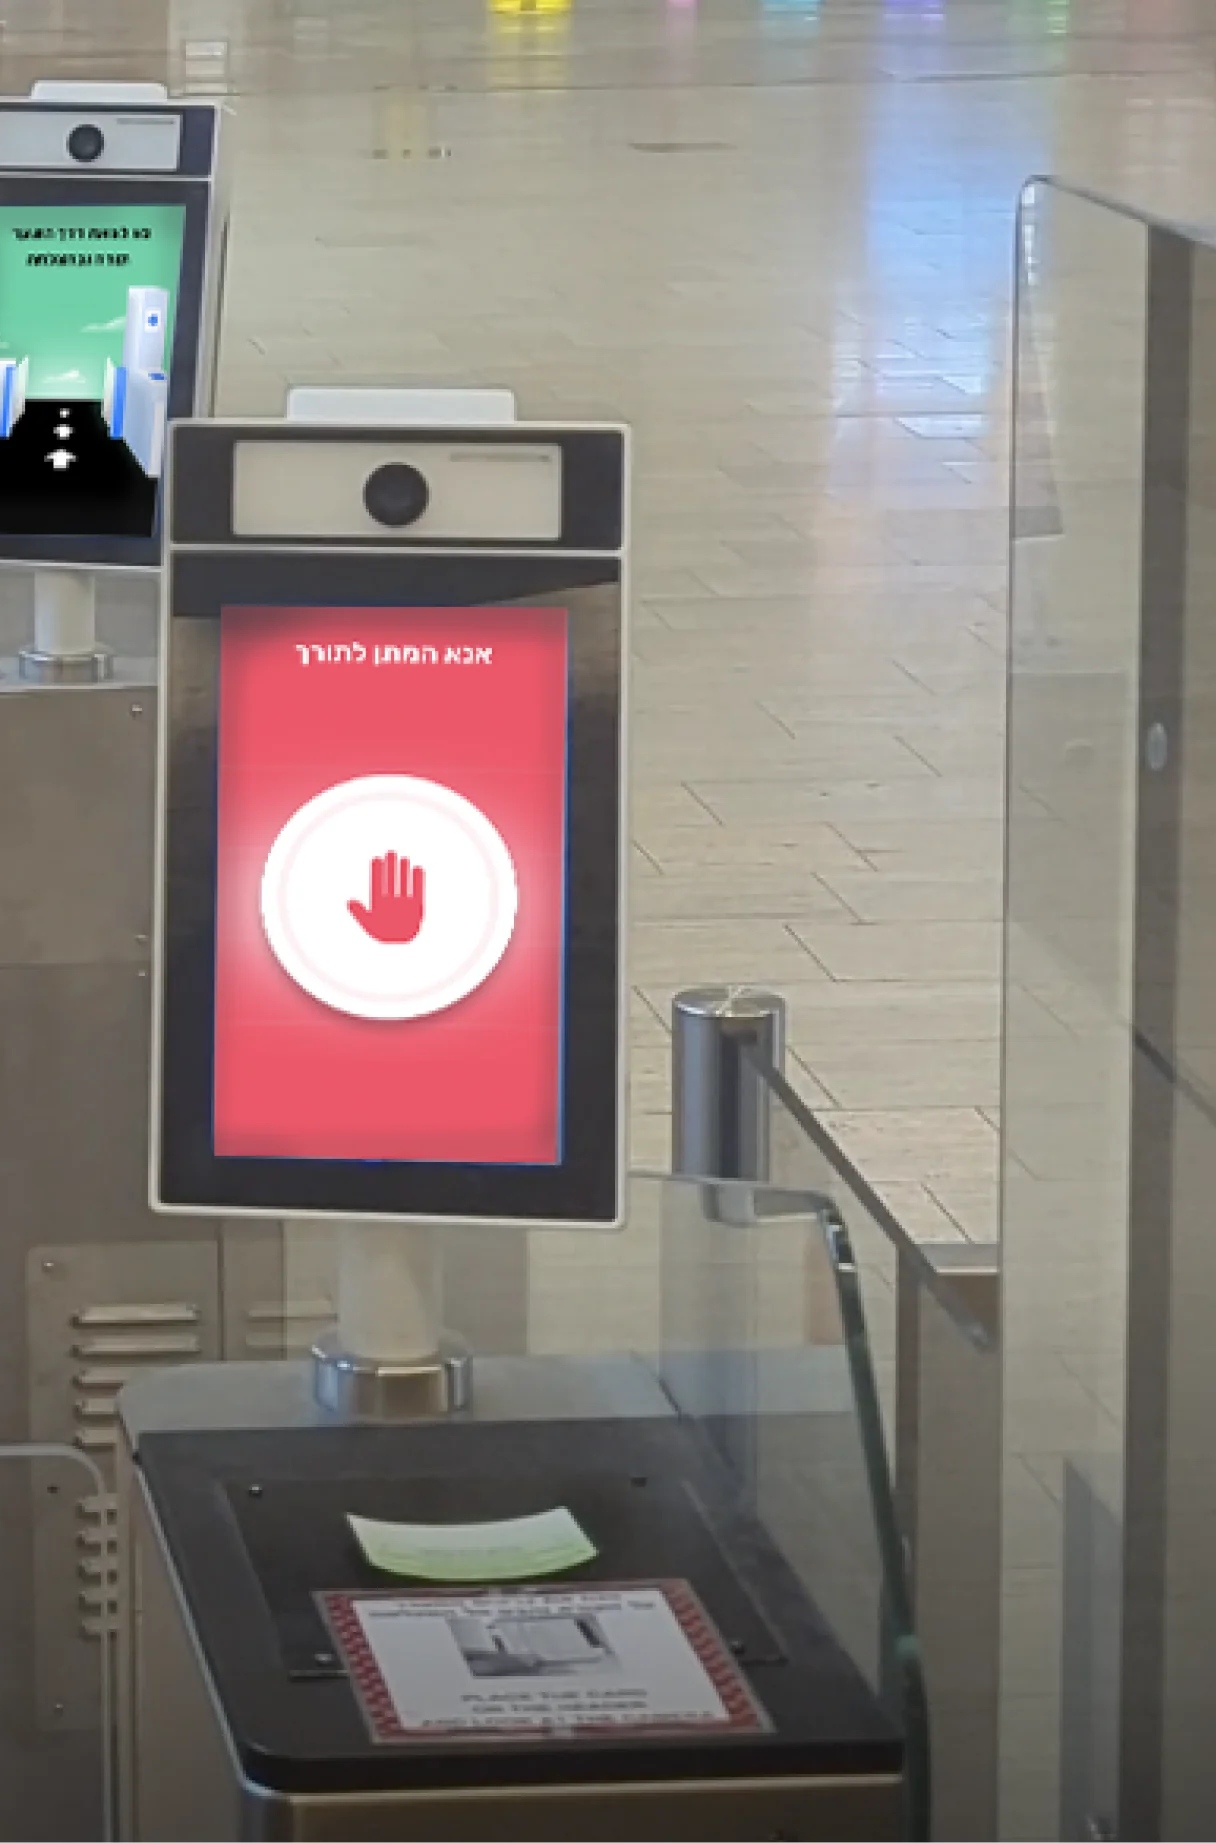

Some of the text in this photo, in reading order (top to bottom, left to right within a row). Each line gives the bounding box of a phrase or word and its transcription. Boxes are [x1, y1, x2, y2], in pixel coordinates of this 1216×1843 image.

[294, 641, 493, 667] אנא המתן לתורך
